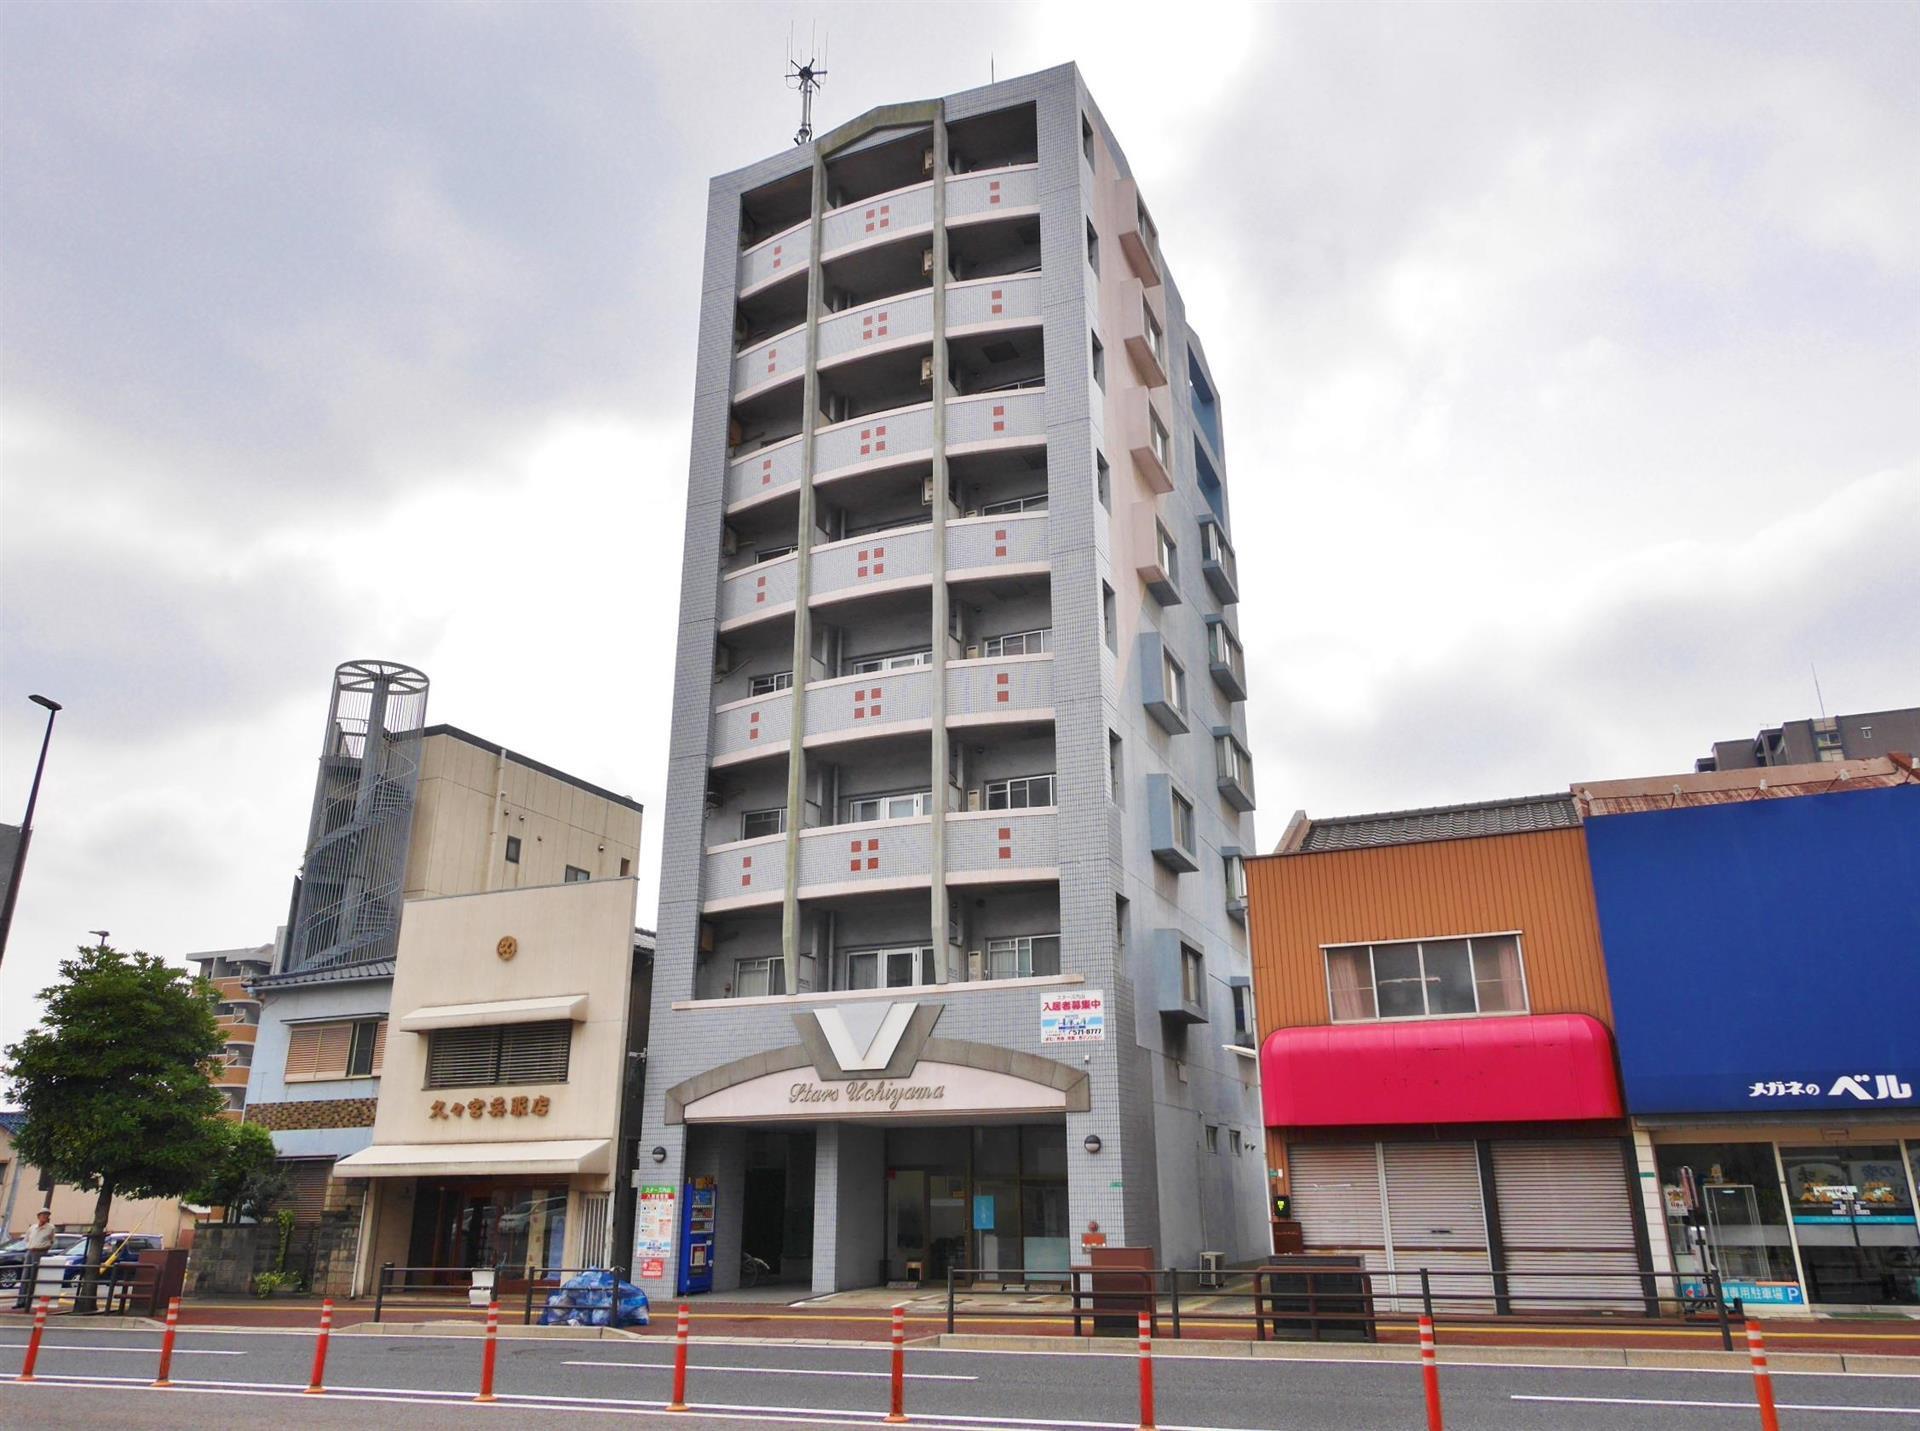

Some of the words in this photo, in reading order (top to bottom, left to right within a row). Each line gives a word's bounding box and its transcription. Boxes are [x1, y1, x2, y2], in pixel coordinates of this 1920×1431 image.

[1043, 999, 1101, 1012] 入居者募集中
[789, 1082, 840, 1103] Stars
[1749, 1081, 1821, 1097] メガネの
[1828, 1074, 1912, 1100] ベル
[429, 1095, 550, 1120] 久々宮呉服店
